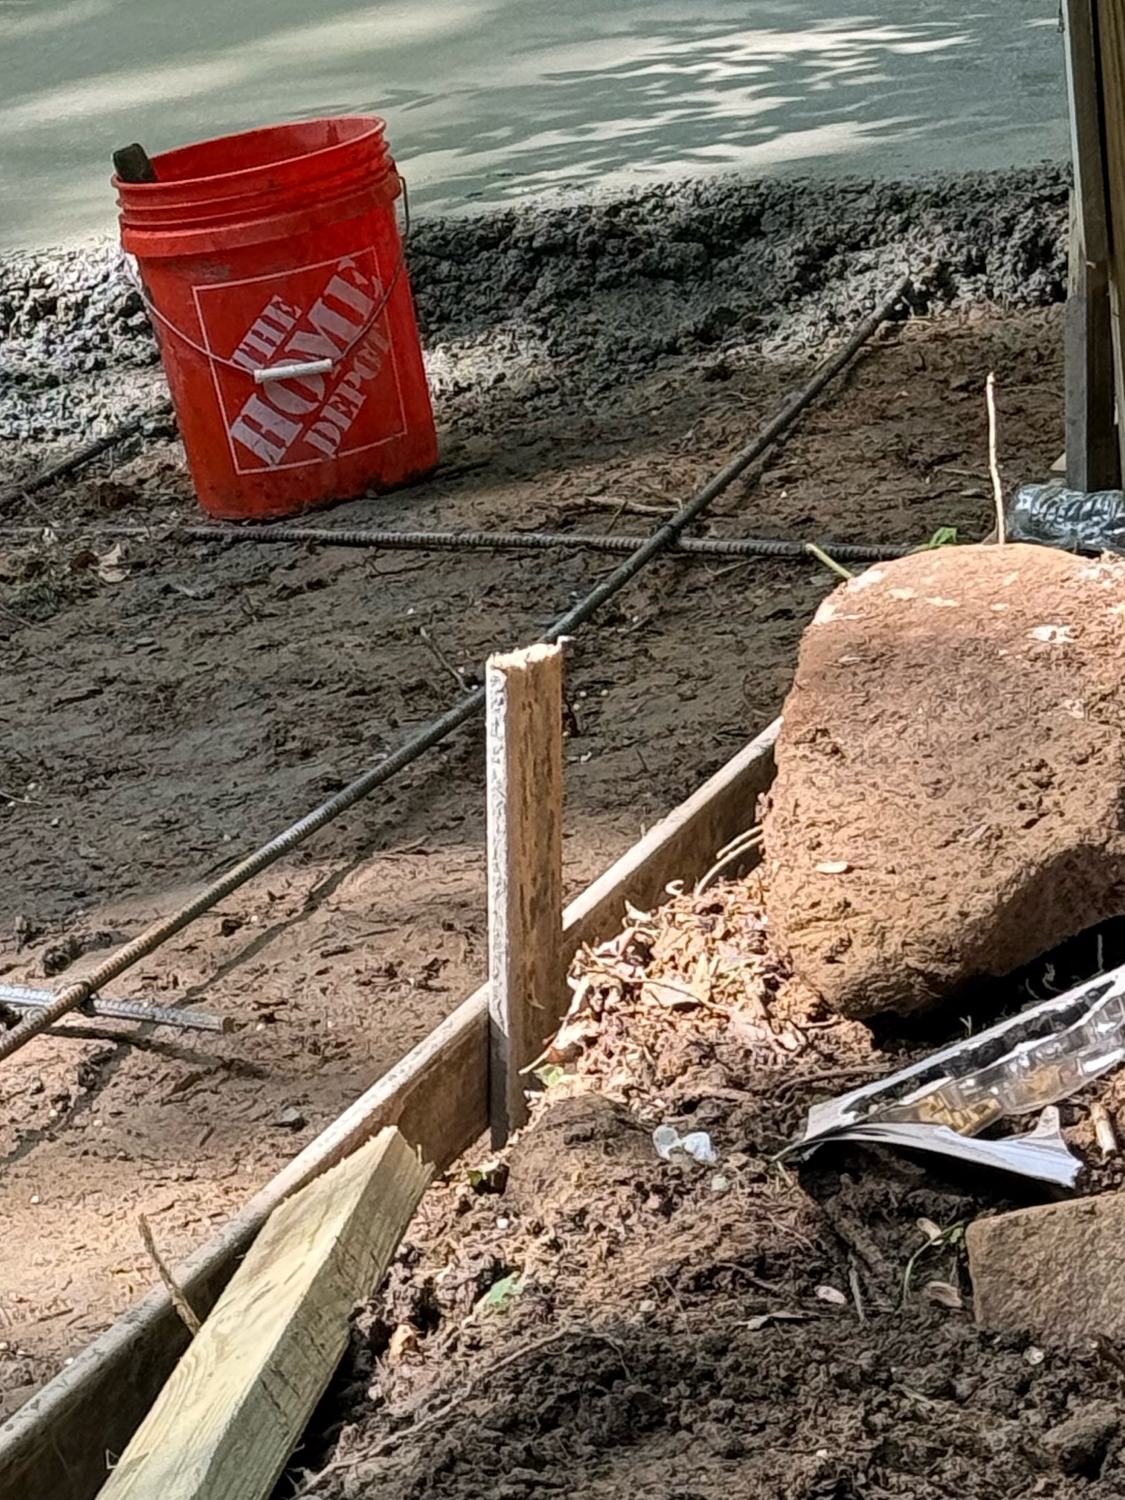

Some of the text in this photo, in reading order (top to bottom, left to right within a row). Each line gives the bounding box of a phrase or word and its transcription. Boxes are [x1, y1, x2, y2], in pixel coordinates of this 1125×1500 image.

[230, 257, 383, 467] HOME
[231, 295, 303, 369] THE
[302, 320, 390, 459] DEPOT
